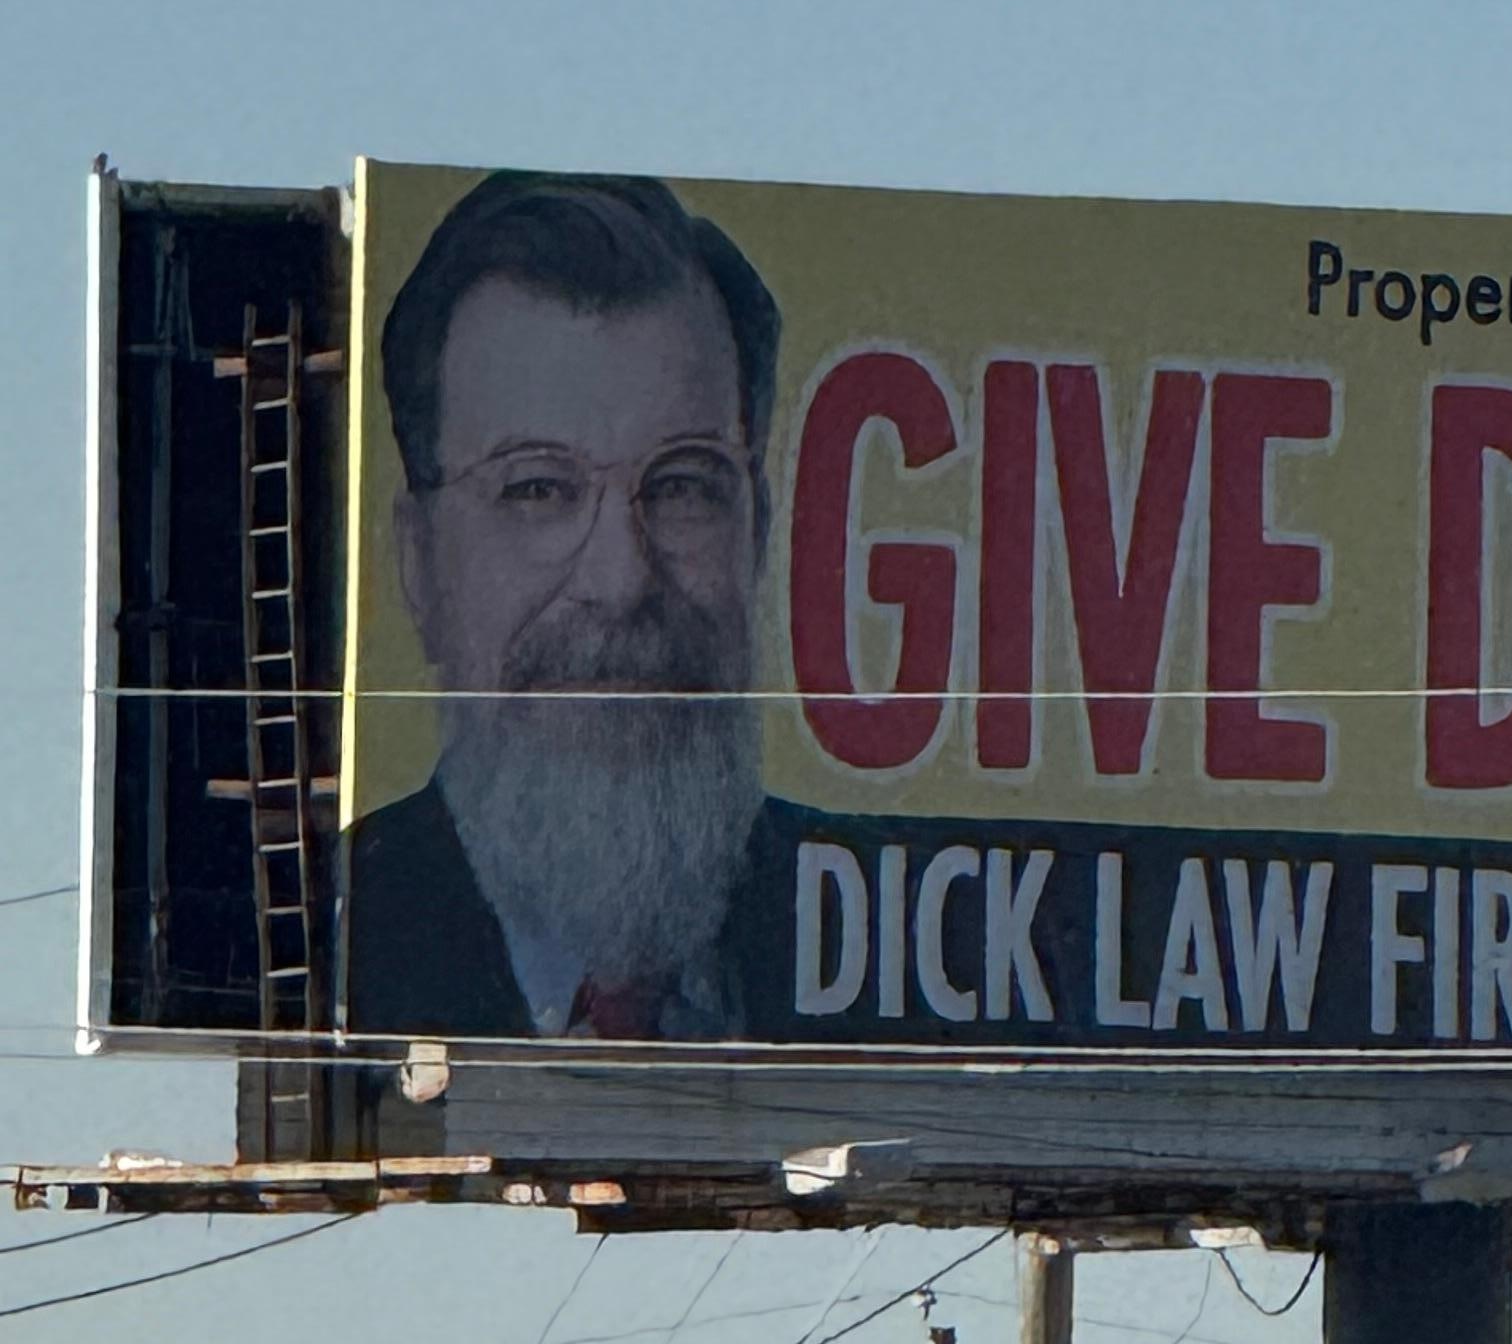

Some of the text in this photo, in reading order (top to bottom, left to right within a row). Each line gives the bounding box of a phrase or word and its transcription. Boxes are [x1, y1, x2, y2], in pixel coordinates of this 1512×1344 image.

[790, 351, 1333, 782] GIVE
[795, 840, 1056, 1022] DICK
[1095, 850, 1334, 1034] LAW
